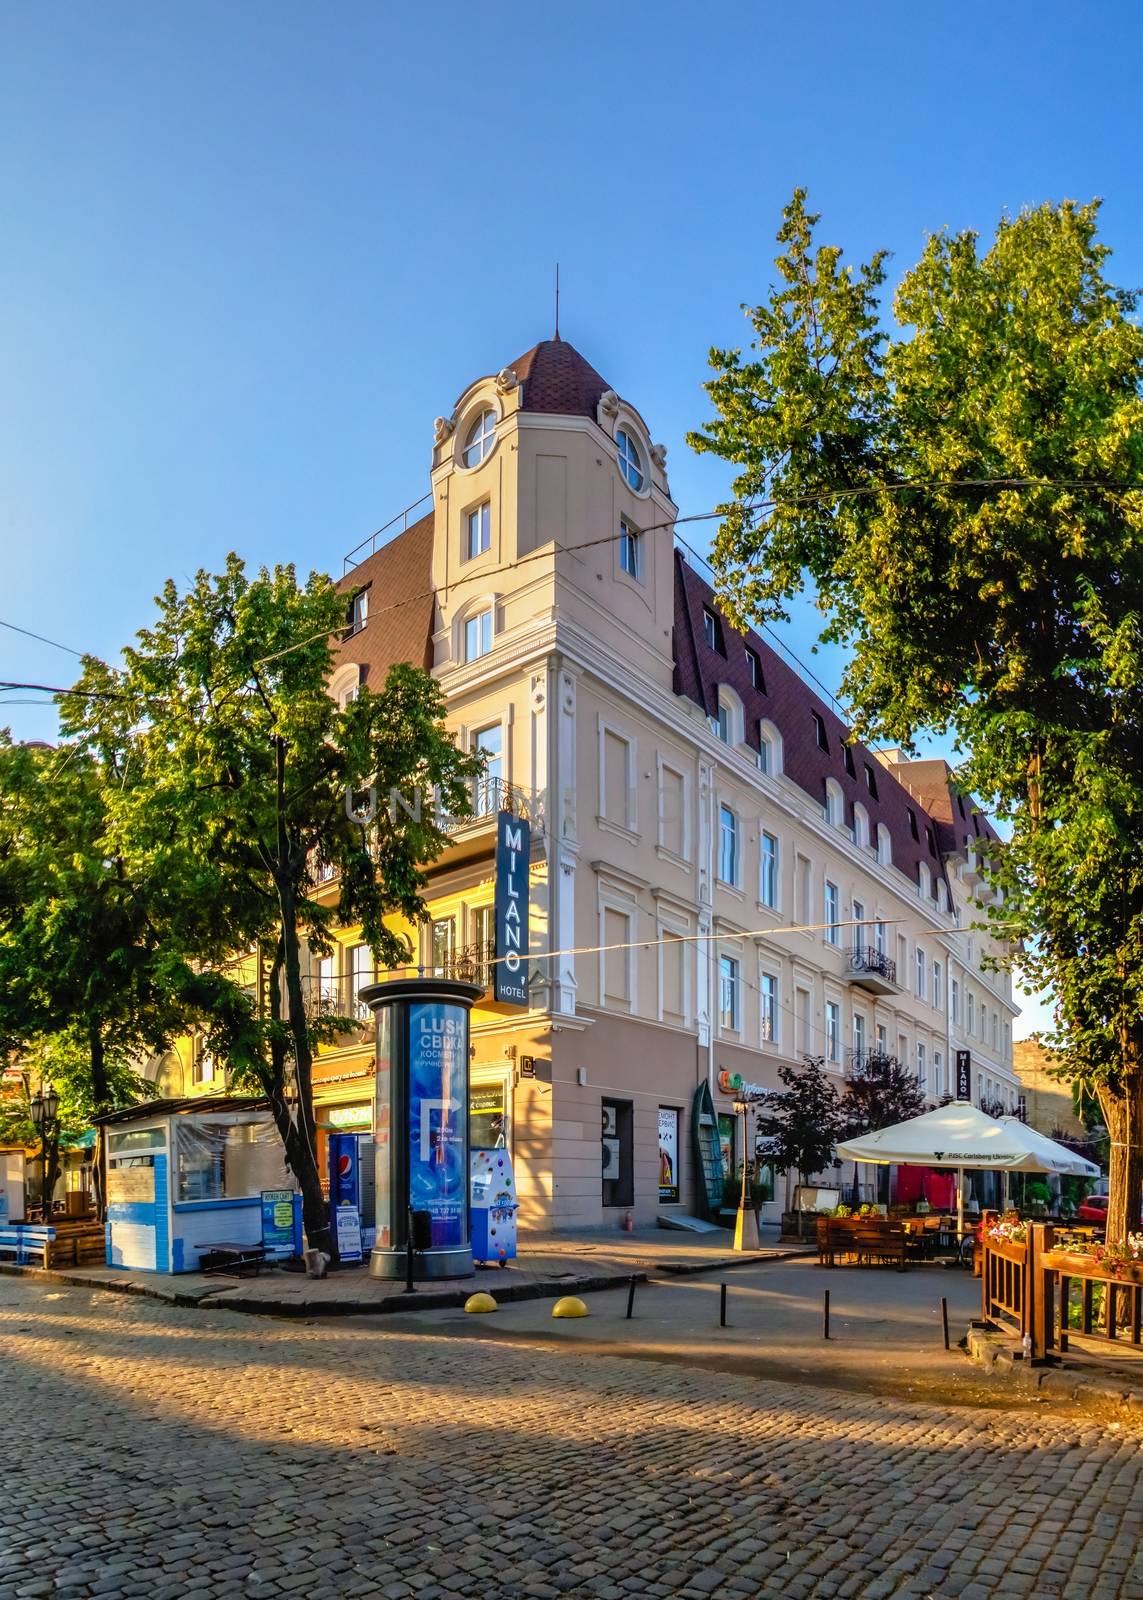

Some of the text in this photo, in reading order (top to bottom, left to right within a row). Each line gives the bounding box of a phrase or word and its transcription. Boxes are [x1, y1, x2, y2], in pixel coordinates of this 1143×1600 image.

[504, 823, 522, 972] MILANO
[499, 985, 526, 999] HOTEL
[420, 1017, 463, 1036] LUSH
[959, 1053, 967, 1093] MILANO
[963, 1153, 992, 1161] Carlsberg
